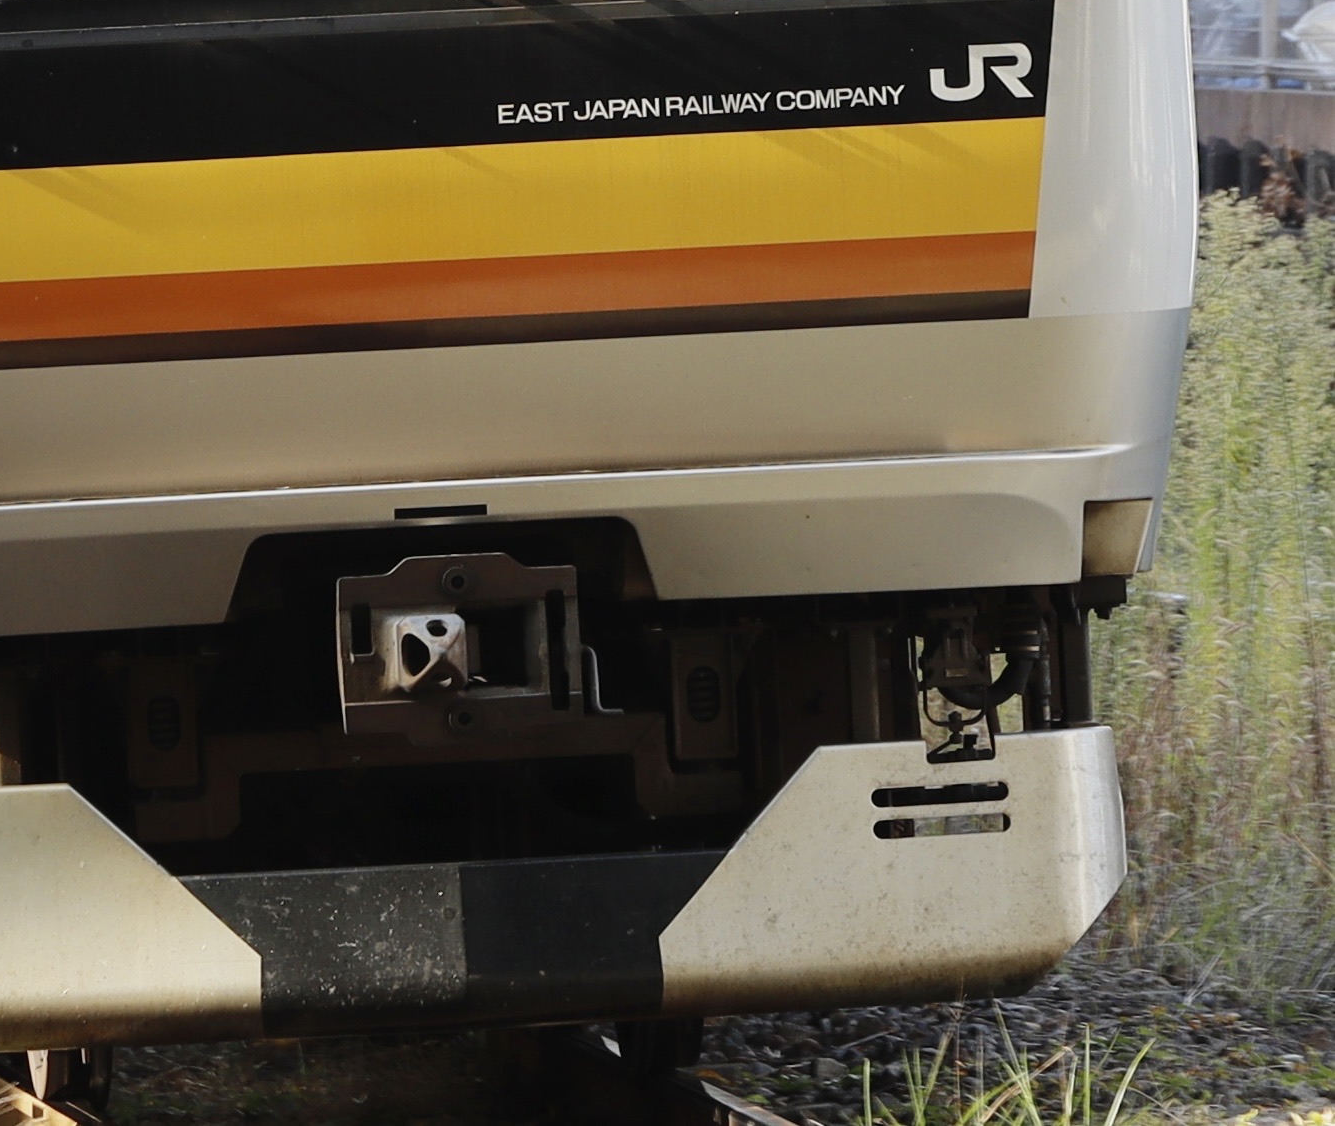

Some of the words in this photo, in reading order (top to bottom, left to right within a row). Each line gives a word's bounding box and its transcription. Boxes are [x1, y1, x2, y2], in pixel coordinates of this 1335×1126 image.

[929, 42, 1034, 102] JR
[497, 101, 570, 124] EAST
[573, 97, 661, 121] JAPAN
[665, 91, 771, 117] RAILWAY
[776, 84, 905, 111] COMPANY
